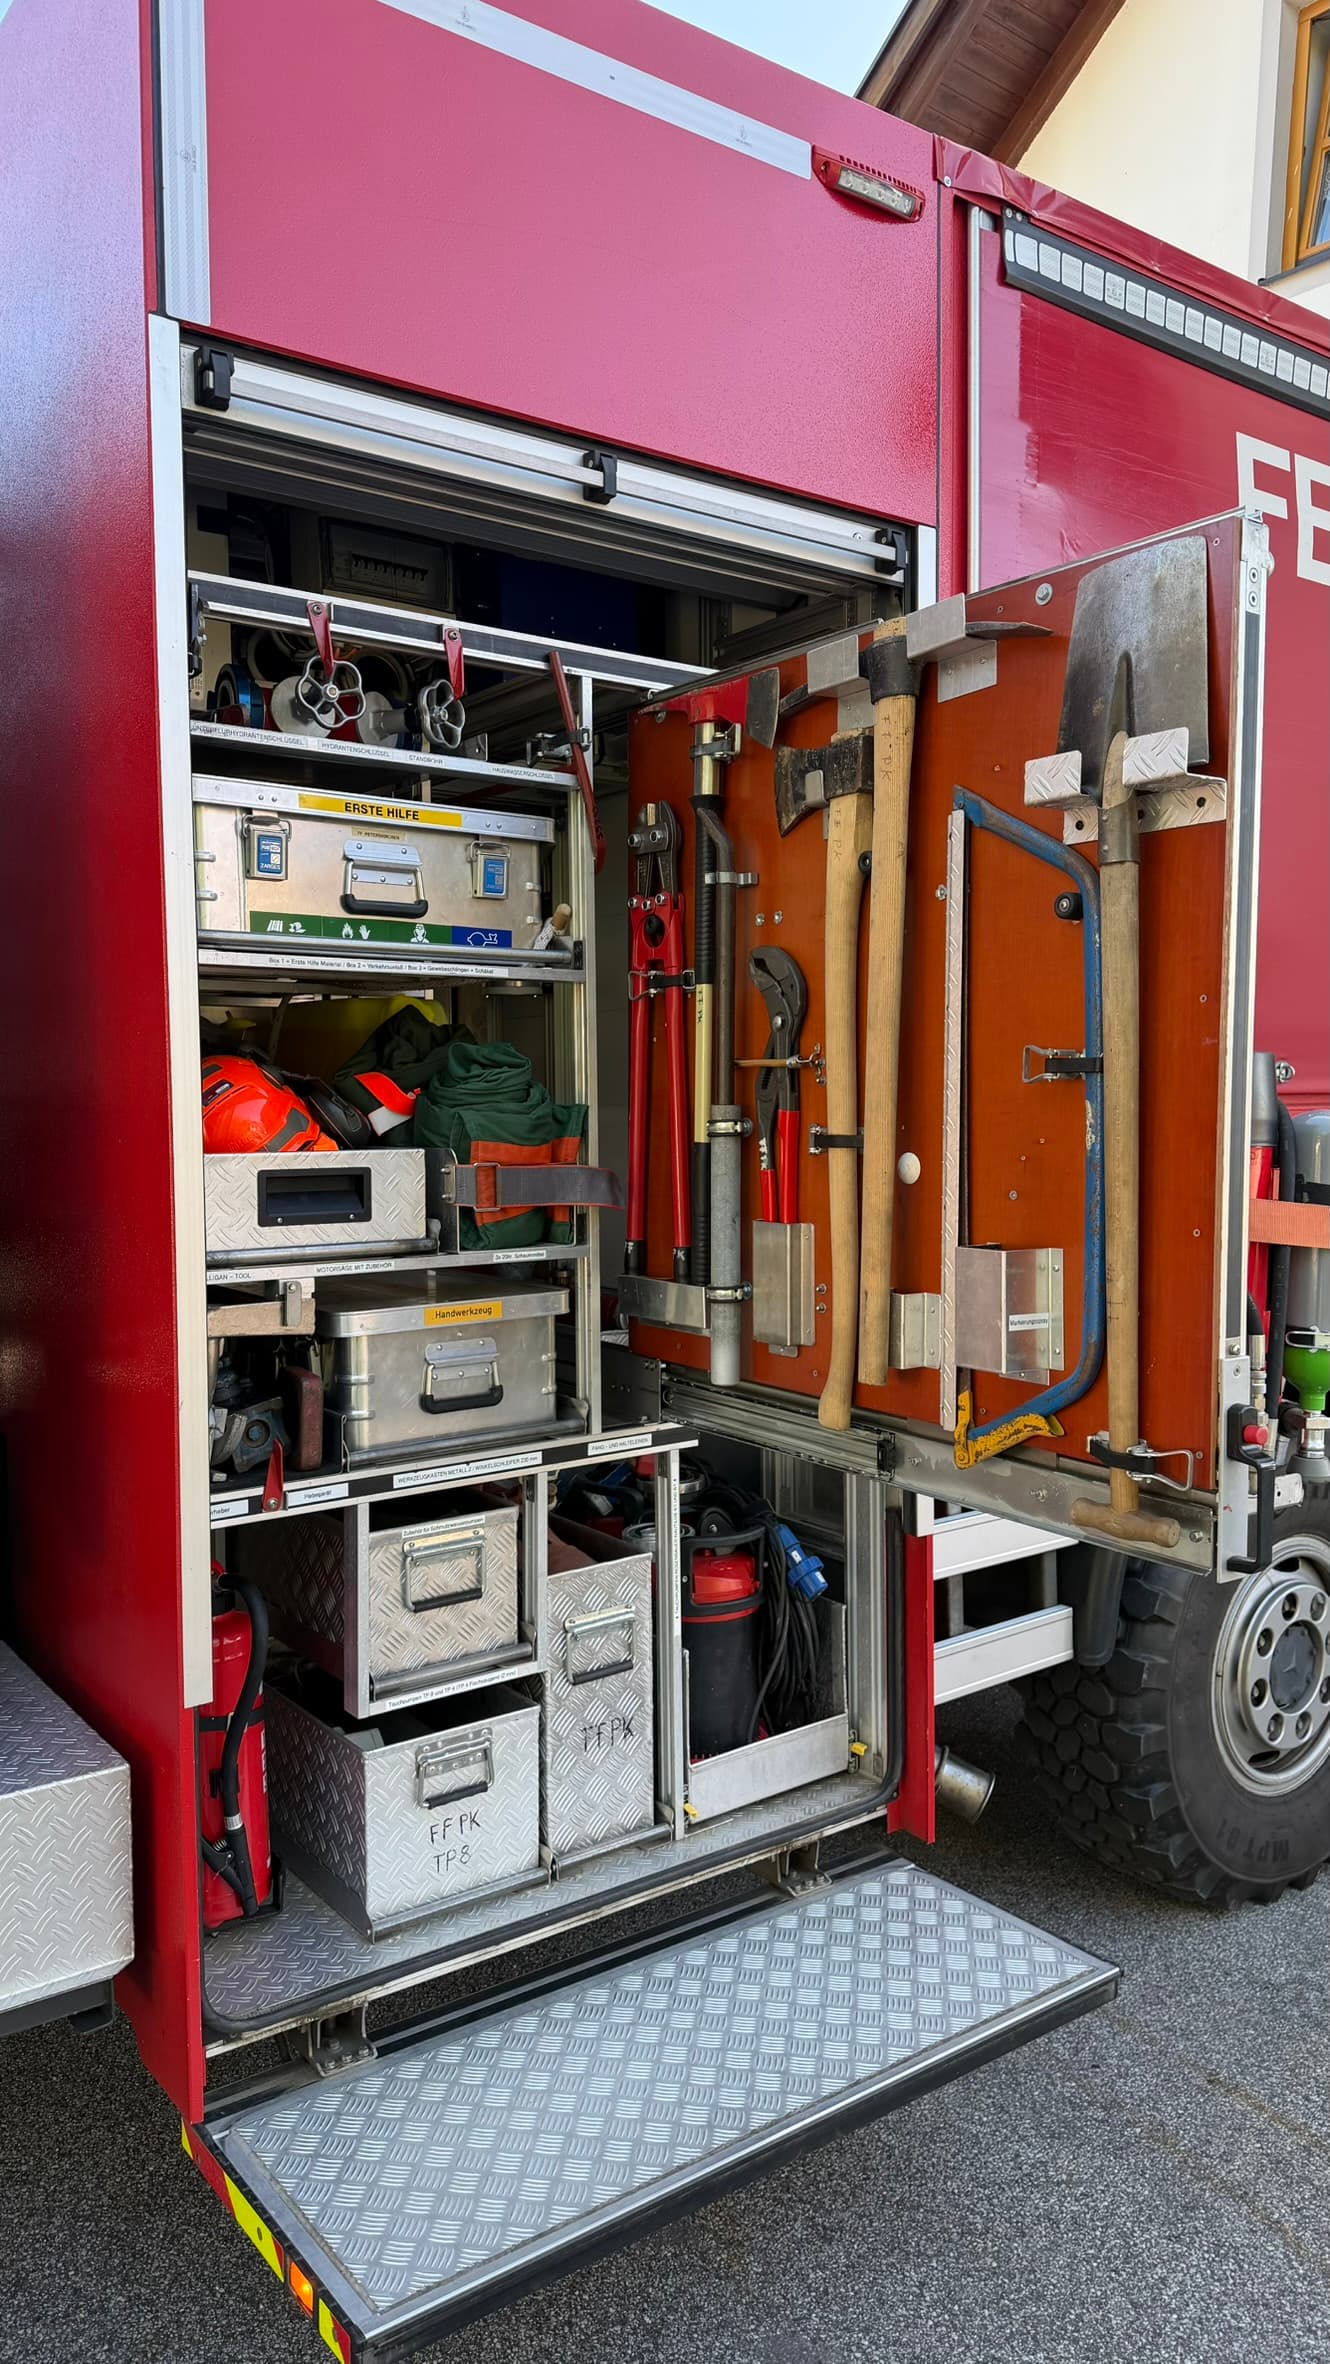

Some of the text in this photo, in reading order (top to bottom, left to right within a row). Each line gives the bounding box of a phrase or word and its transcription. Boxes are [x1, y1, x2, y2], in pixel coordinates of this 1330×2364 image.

[344, 802, 419, 820] ERSTE HILFE
[354, 1263, 364, 1271] MIT
[365, 1261, 392, 1270] ZUBEHÖR
[435, 1307, 492, 1319] Handwerkzeug
[398, 1471, 448, 1484] WERKZEUGKASTEN
